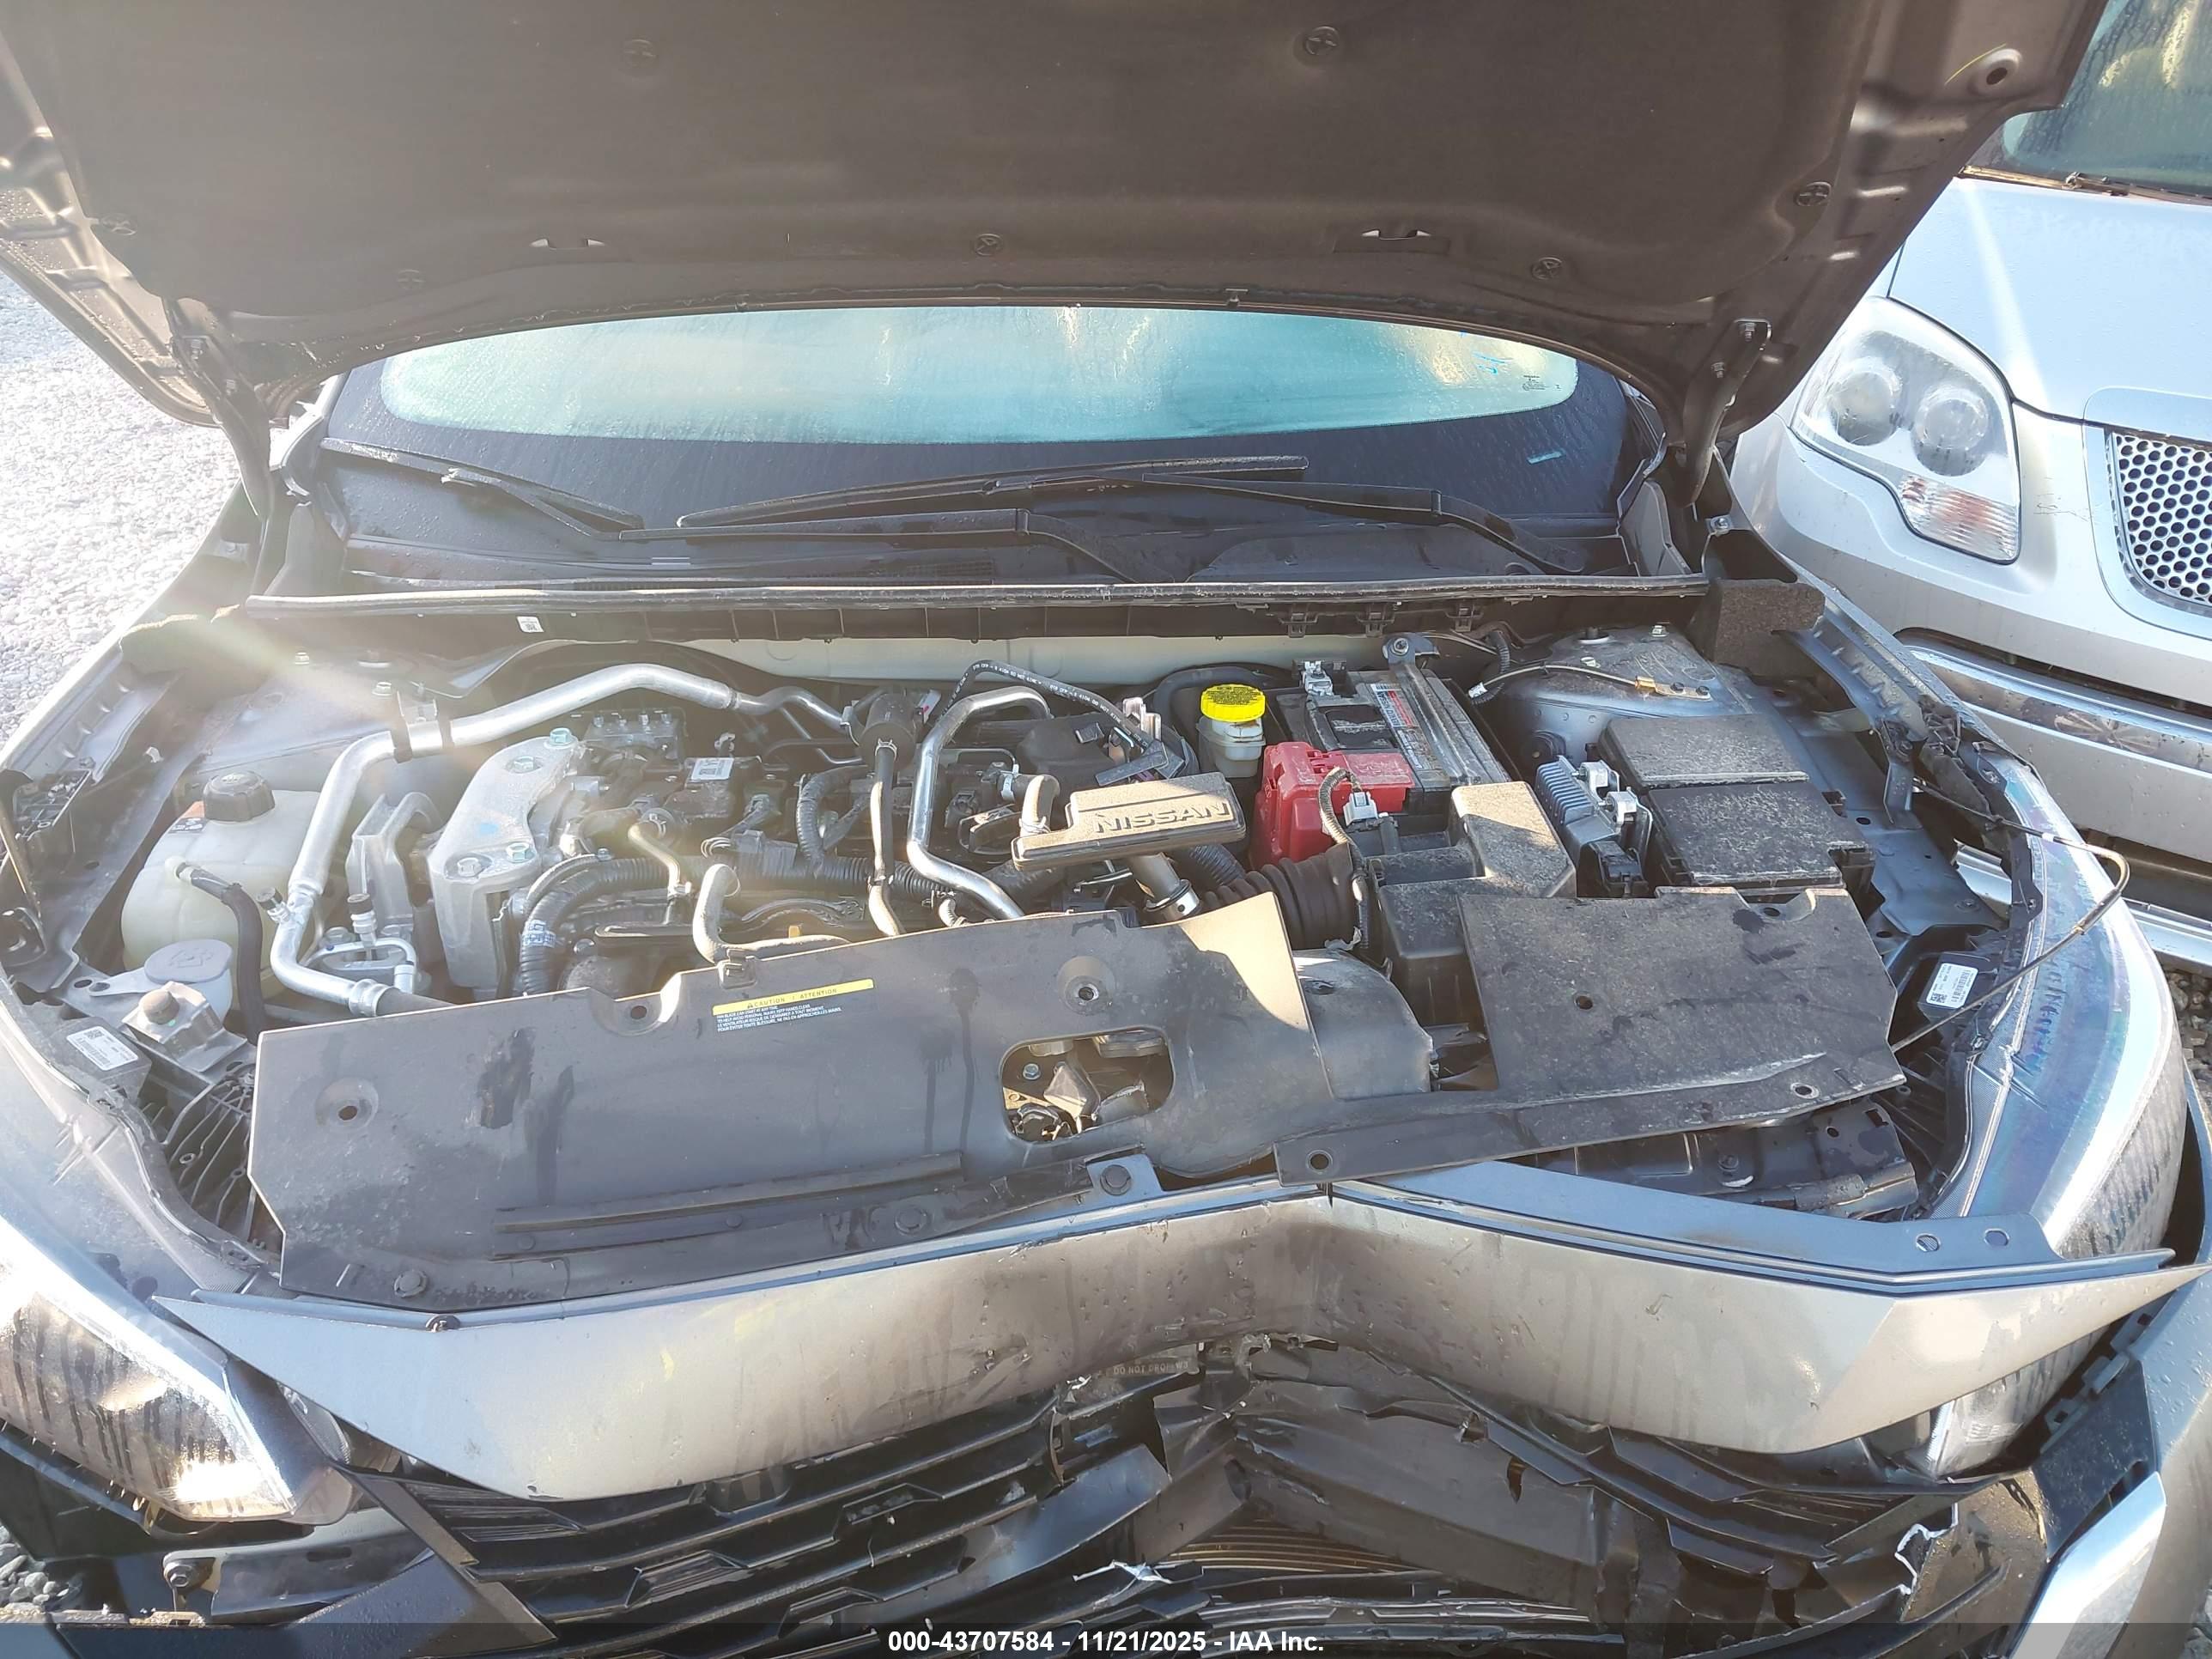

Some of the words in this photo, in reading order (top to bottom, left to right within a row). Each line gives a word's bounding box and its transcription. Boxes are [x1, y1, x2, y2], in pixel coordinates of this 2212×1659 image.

[1092, 802, 1231, 834] NISSAN
[754, 997, 785, 1007] CAUTION
[799, 988, 837, 1000] ATTENTION
